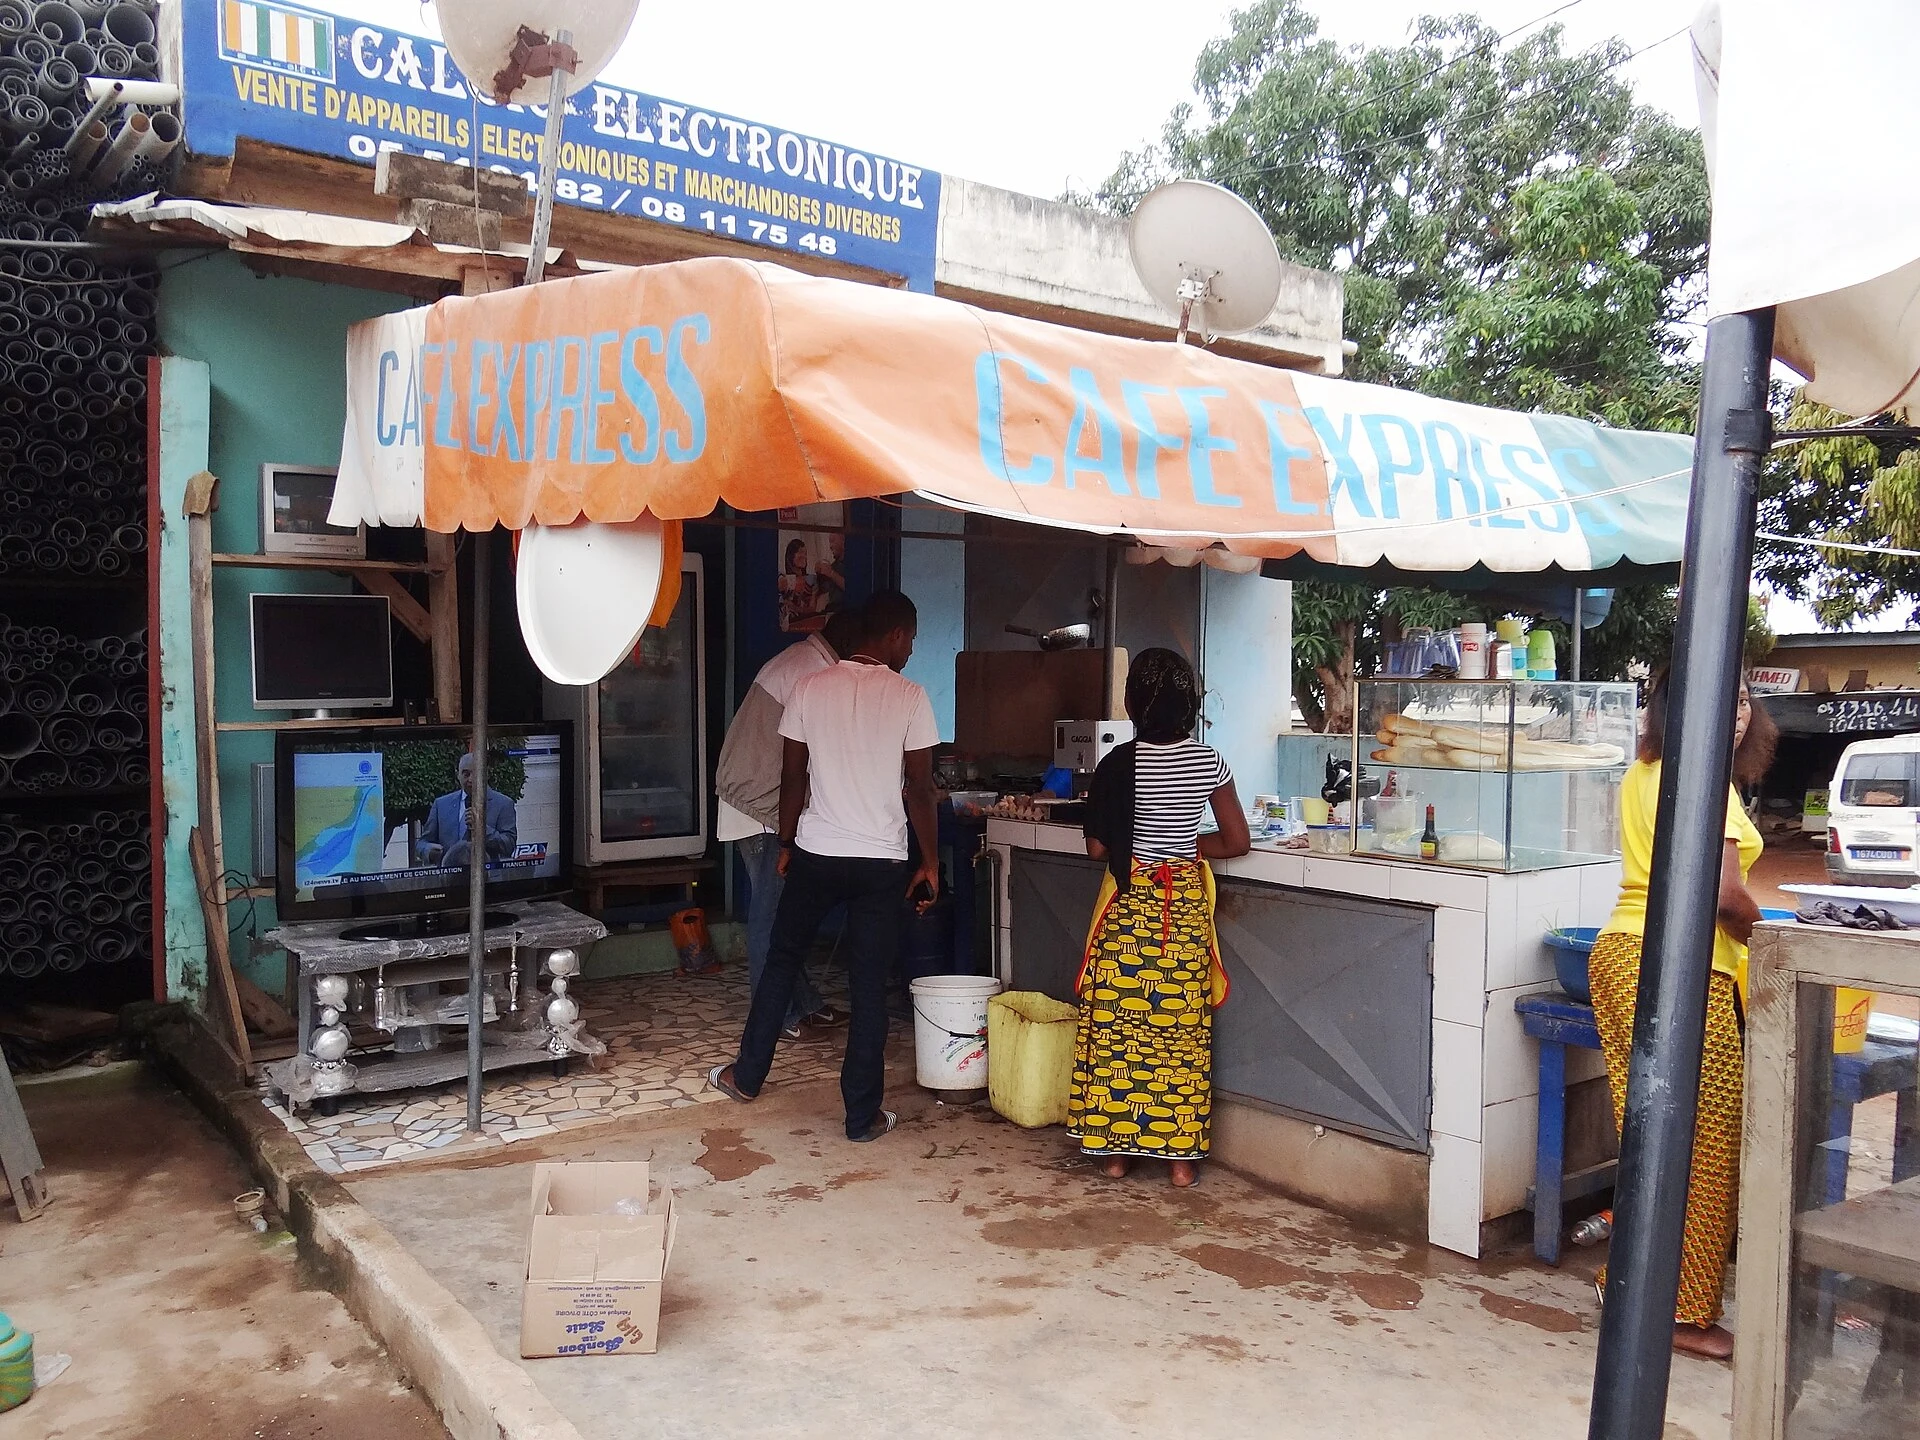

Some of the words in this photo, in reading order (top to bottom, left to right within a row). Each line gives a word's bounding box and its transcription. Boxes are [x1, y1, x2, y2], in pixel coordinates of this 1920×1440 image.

[232, 64, 319, 116] VENTE
[324, 87, 470, 149] D'APPAREILS
[482, 123, 650, 188] ELECTONIQUES
[654, 161, 679, 193] ET
[685, 168, 821, 226] MARCHANDISES
[825, 206, 901, 243] DIVERSES
[591, 84, 925, 210] ELECTRONIQUE
[556, 178, 604, 206] 82
[641, 197, 687, 223] 08
[700, 210, 737, 235] 11
[748, 220, 789, 245] 75
[798, 231, 837, 256] 48
[377, 338, 461, 450] CAFE
[469, 312, 712, 465] EXPRESS
[974, 350, 1243, 509] CAFE
[1264, 398, 1625, 537] EXPRESS
[1747, 669, 1792, 684] AHMED
[360, 872, 402, 882] MOUVEMENT
[414, 867, 463, 877] CONTESTATION
[557, 1336, 624, 1354] Bonbon
[565, 1320, 606, 1334] Lait
